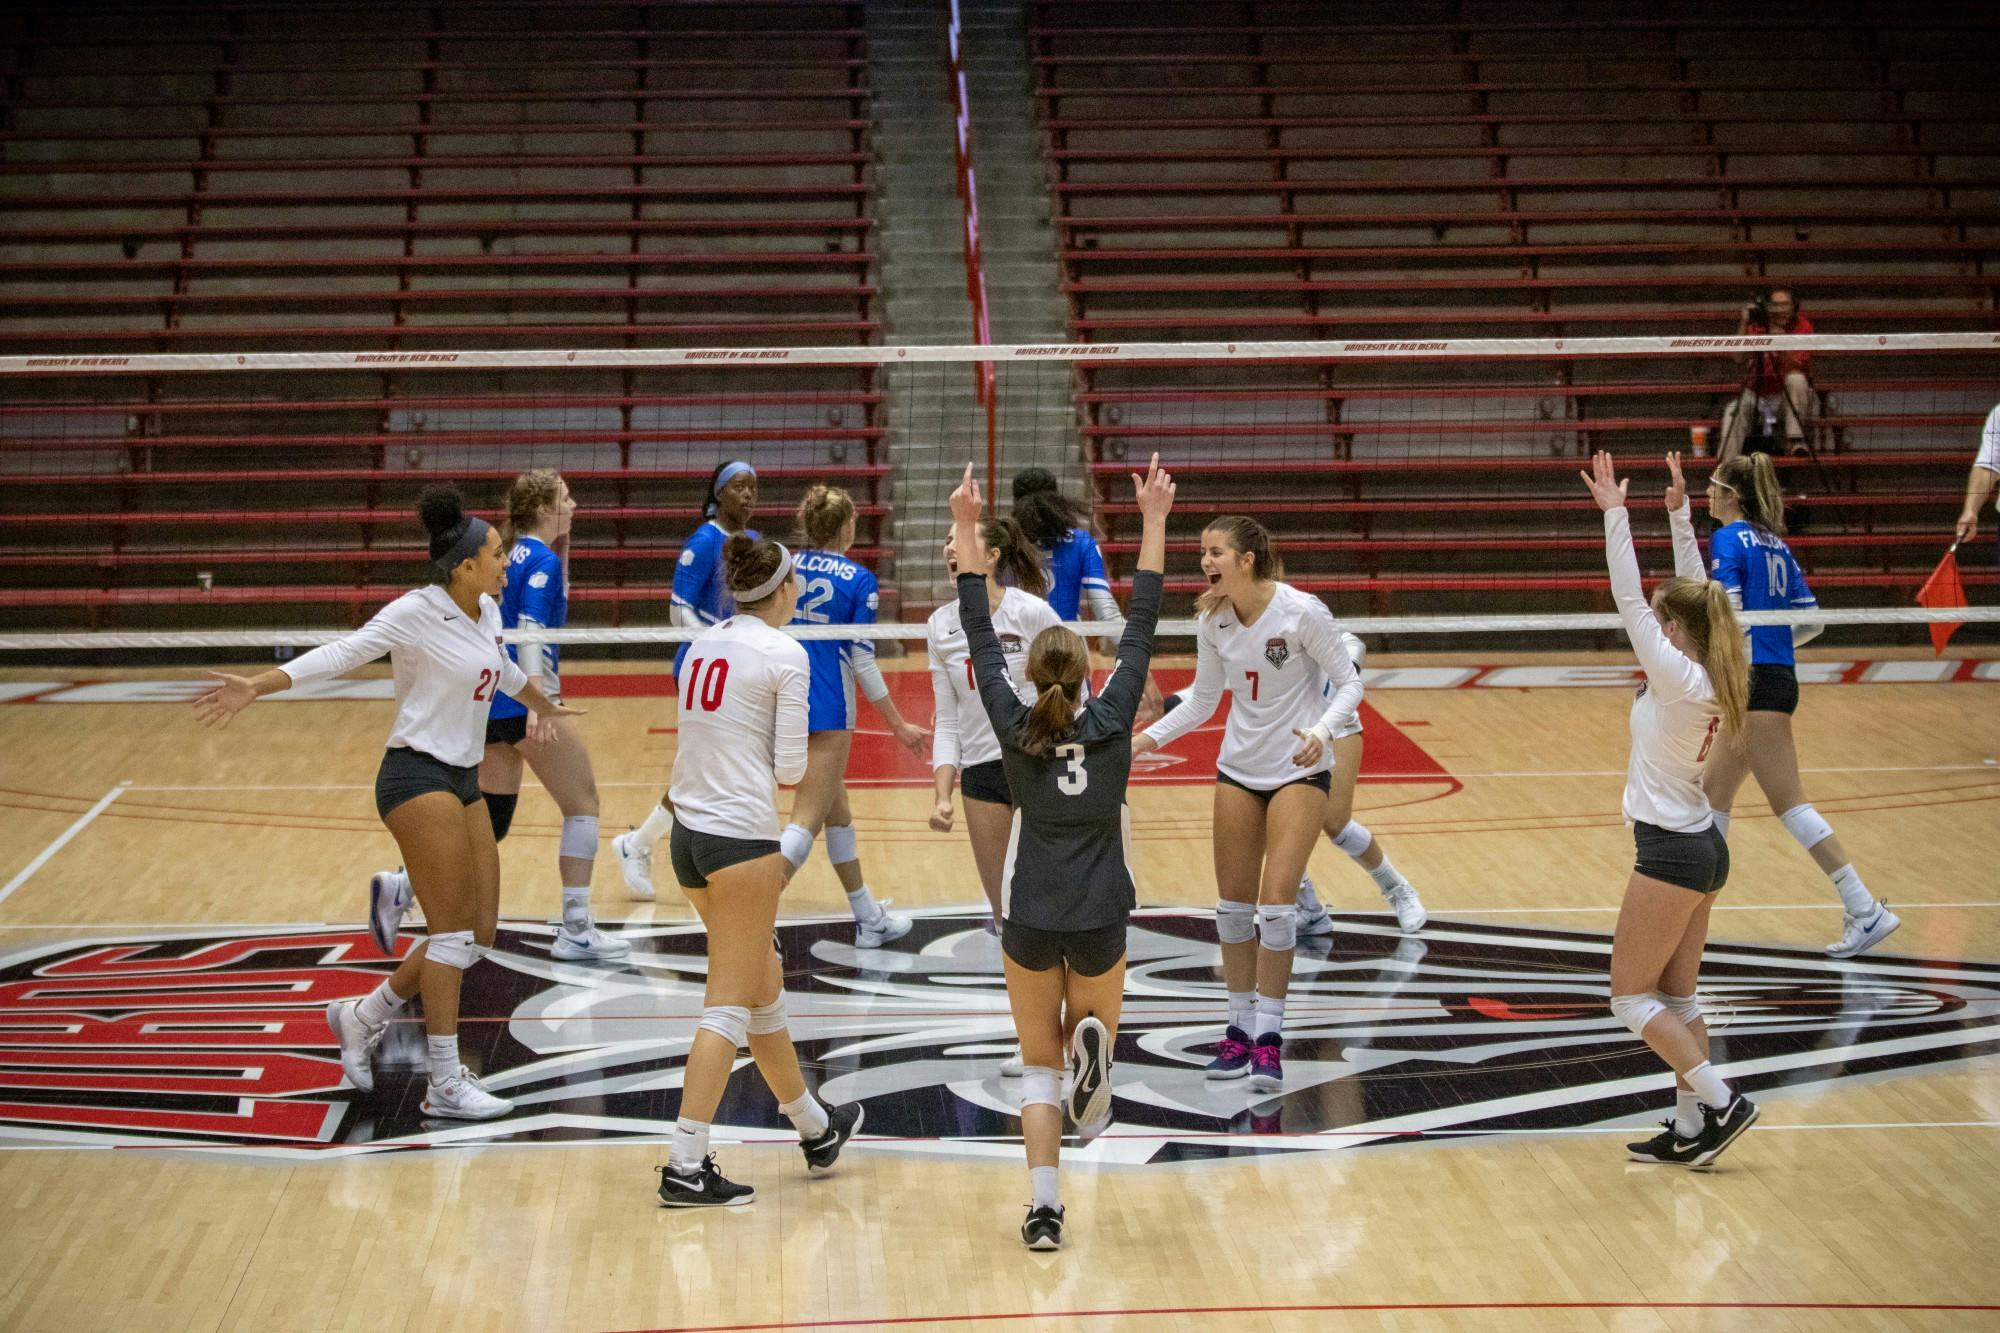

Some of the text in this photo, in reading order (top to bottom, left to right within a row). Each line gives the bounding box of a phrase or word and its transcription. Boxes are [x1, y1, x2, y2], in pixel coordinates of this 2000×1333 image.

[1088, 346, 1119, 354] MEXICO
[1343, 343, 1389, 351] UNIVERSITY
[1417, 342, 1448, 350] MEXICO
[1670, 339, 1714, 347] UNIVERSITY
[1742, 338, 1773, 346] MEXICO
[99, 358, 129, 366] MEXICO
[354, 354, 399, 362] UNIVERSITY
[684, 351, 730, 359] UNIVERSITY
[790, 553, 857, 581] ALCONS
[1765, 552, 1788, 598] 10
[473, 668, 501, 702] 21
[685, 657, 730, 712] 10
[1245, 671, 1259, 702] 7
[1055, 743, 1088, 796] 3
